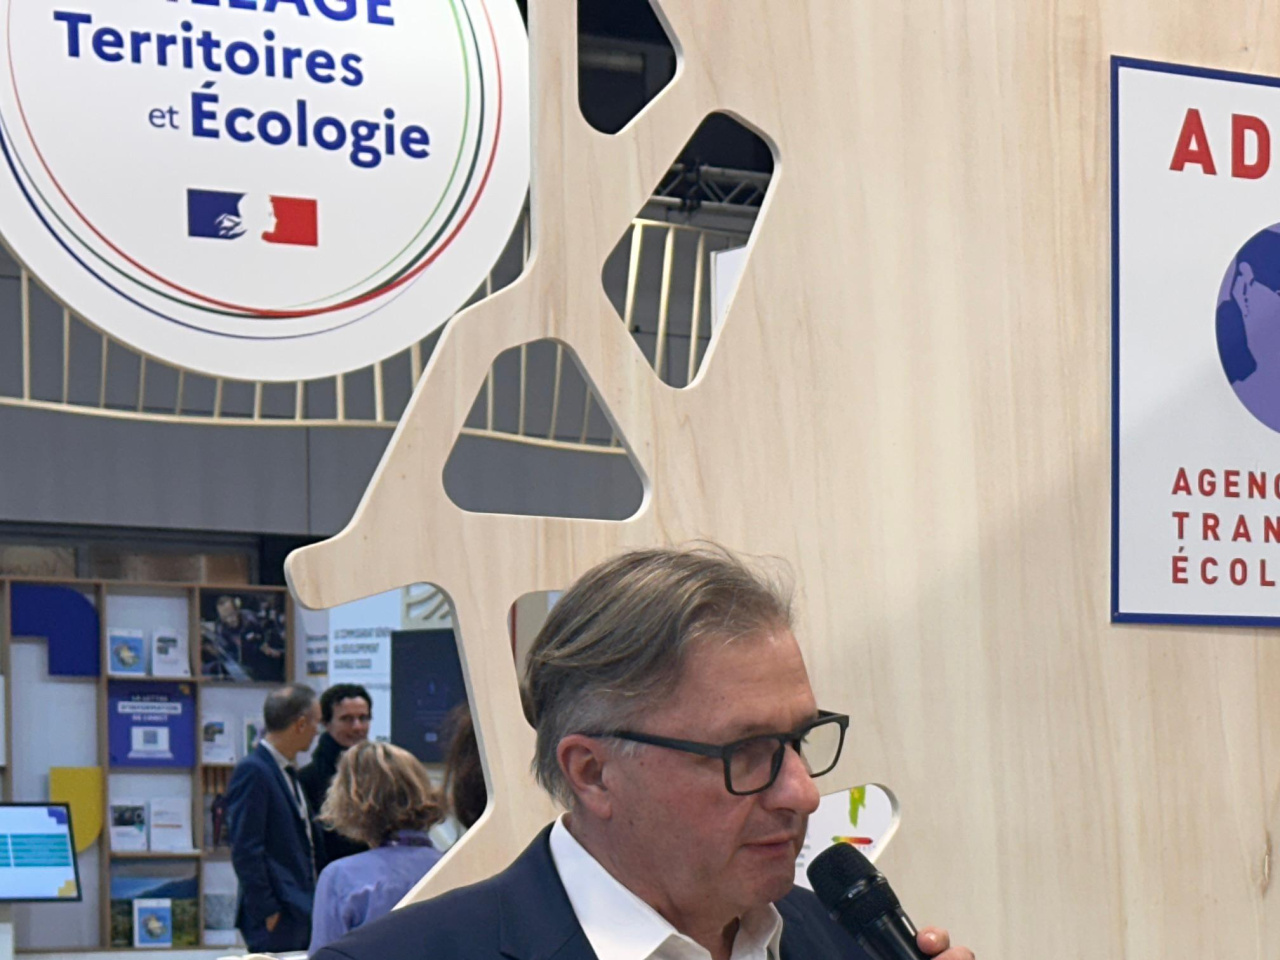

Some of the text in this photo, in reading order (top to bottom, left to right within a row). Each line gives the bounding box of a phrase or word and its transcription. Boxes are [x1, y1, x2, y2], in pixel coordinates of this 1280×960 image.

[53, 10, 364, 87] Territoires
[148, 81, 431, 168] et Écologie
